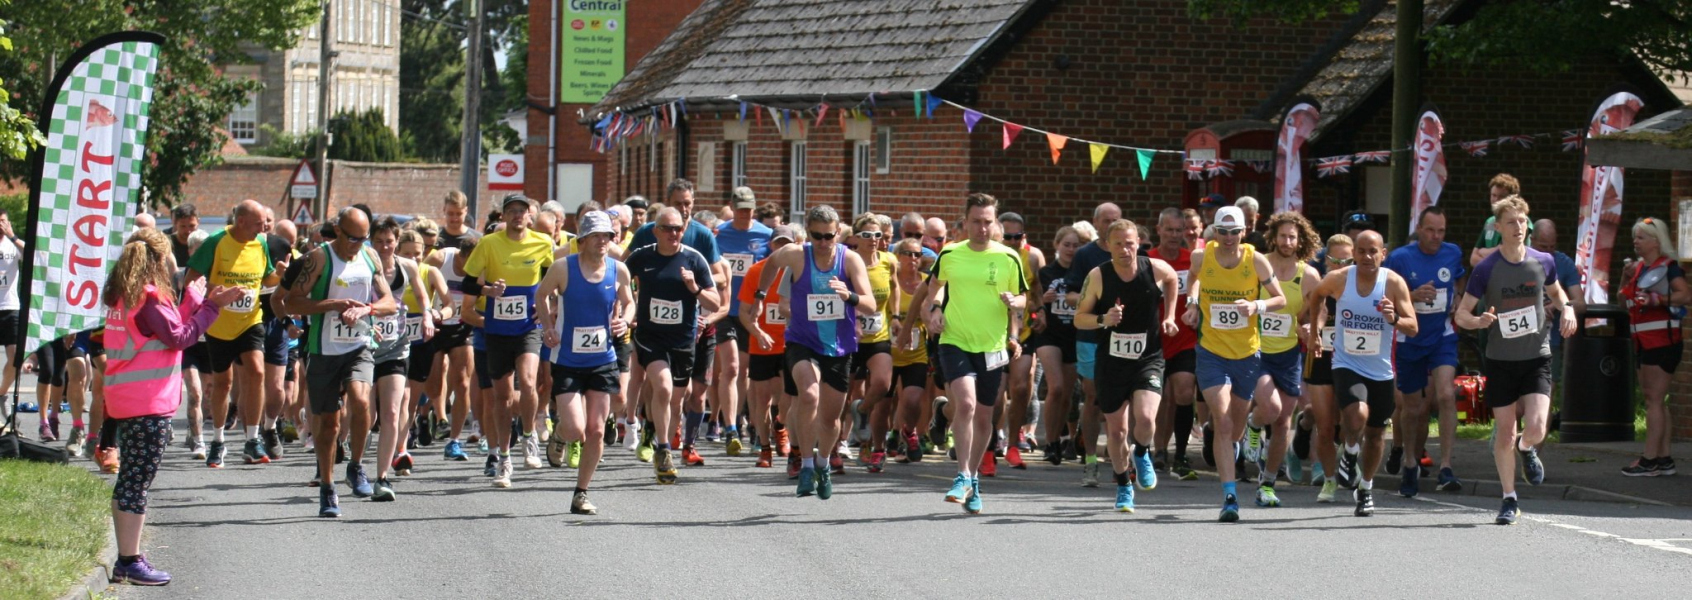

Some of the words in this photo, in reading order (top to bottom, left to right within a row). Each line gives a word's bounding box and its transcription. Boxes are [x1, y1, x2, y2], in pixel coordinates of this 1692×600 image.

[571, 0, 621, 10] Central
[66, 141, 114, 310] START
[729, 260, 745, 272] 78
[1202, 288, 1224, 296] AVON
[1225, 288, 1254, 297] VALLEY
[497, 302, 524, 315] 145
[653, 305, 679, 320] 128
[816, 301, 834, 315] 91
[1219, 311, 1239, 324] 89
[1354, 314, 1385, 324] ROYAL
[1508, 315, 1529, 332] 54
[1263, 318, 1282, 331] 62
[1340, 320, 1353, 329] AIR
[1354, 322, 1385, 331] FORCE
[581, 333, 600, 347] 24
[1114, 339, 1143, 354] 110
[1356, 336, 1366, 350] 2
